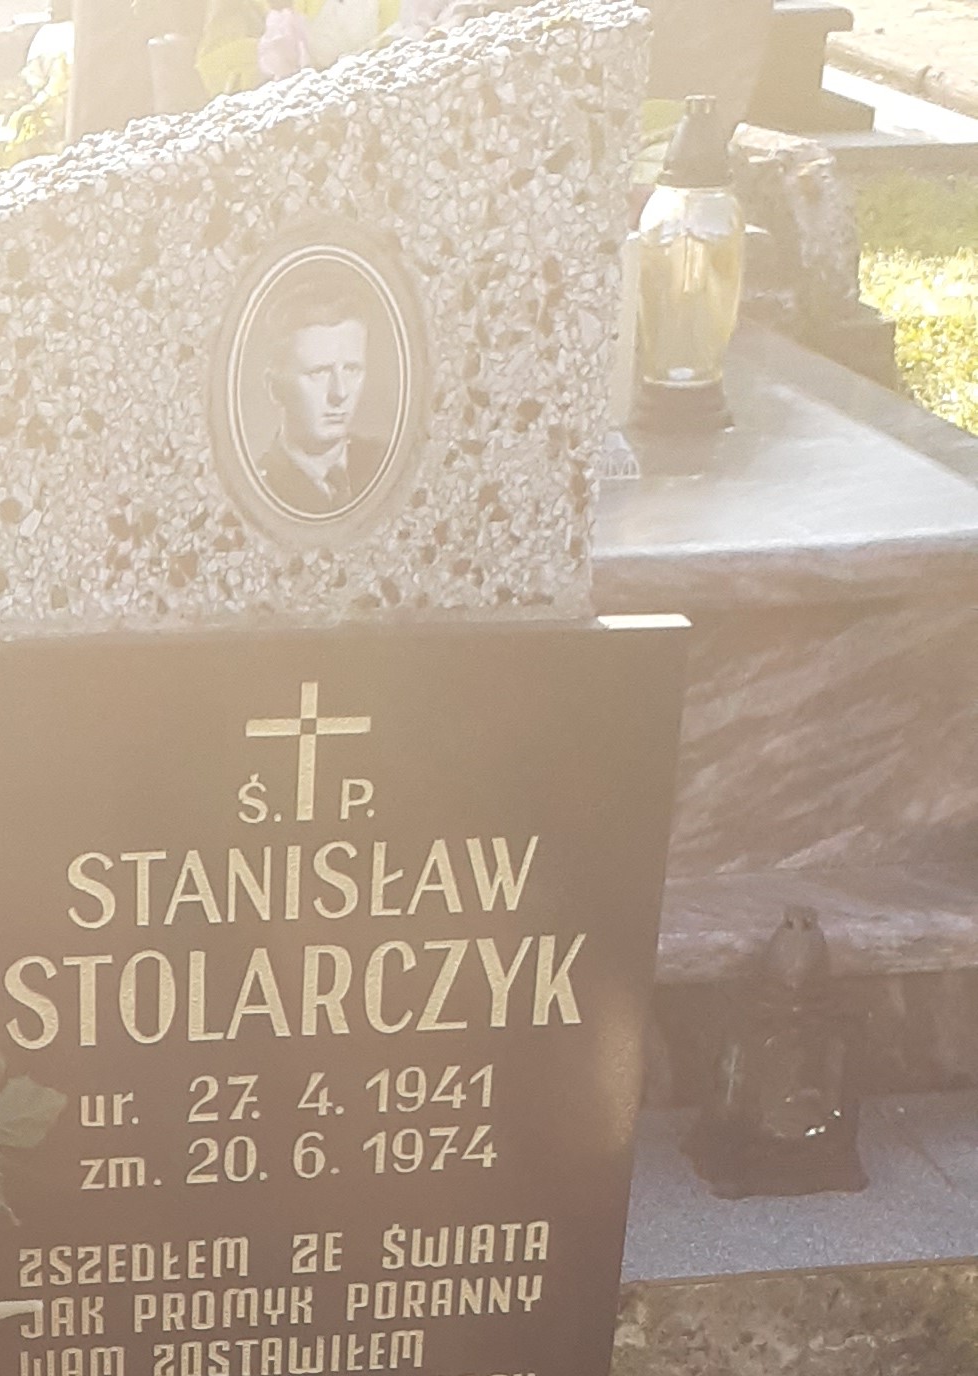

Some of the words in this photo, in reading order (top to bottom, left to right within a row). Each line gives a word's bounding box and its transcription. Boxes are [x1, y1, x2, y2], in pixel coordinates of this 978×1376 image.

[238, 773, 282, 824] Ś.
[340, 778, 375, 820] P.
[67, 835, 539, 929] STANISŁAW
[4, 933, 587, 1050] STOLARCZYK
[80, 1090, 140, 1127] ur.
[187, 1074, 261, 1123] 27.
[297, 1072, 345, 1117] 4.
[365, 1063, 494, 1114] 1941
[80, 1156, 162, 1190] zm.
[186, 1135, 269, 1184] 20.
[293, 1131, 340, 1179] 6.
[362, 1124, 498, 1174] 1974
[19, 1236, 249, 1288] ZSZEDŁEM
[291, 1231, 343, 1274] ZE
[382, 1220, 550, 1270] ŚWIATA
[20, 1296, 105, 1339] JAK
[134, 1286, 313, 1333] PROMYK
[346, 1274, 543, 1321] PORANNY
